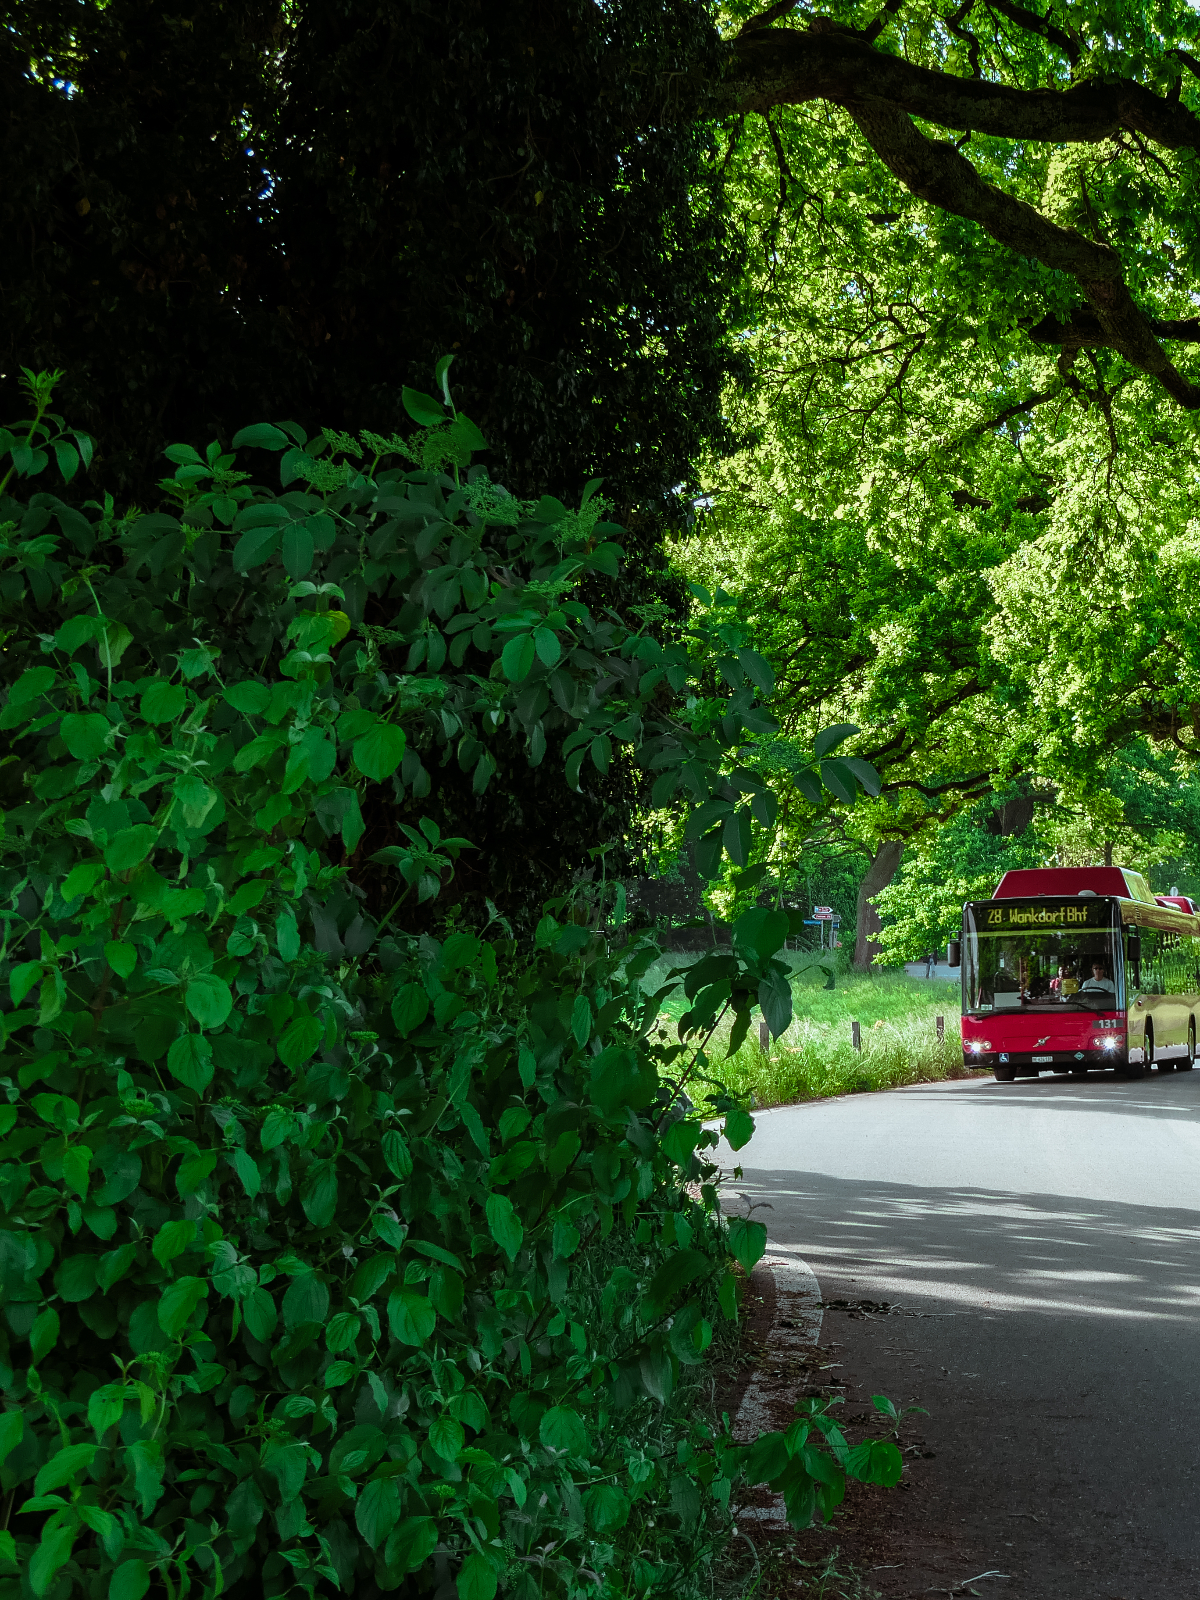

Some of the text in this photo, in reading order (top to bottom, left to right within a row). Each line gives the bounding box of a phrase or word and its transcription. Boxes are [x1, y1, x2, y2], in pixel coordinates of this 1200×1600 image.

[987, 906, 1088, 924] 28 Wankdorf Bhf
[1098, 1019, 1117, 1029] 131
